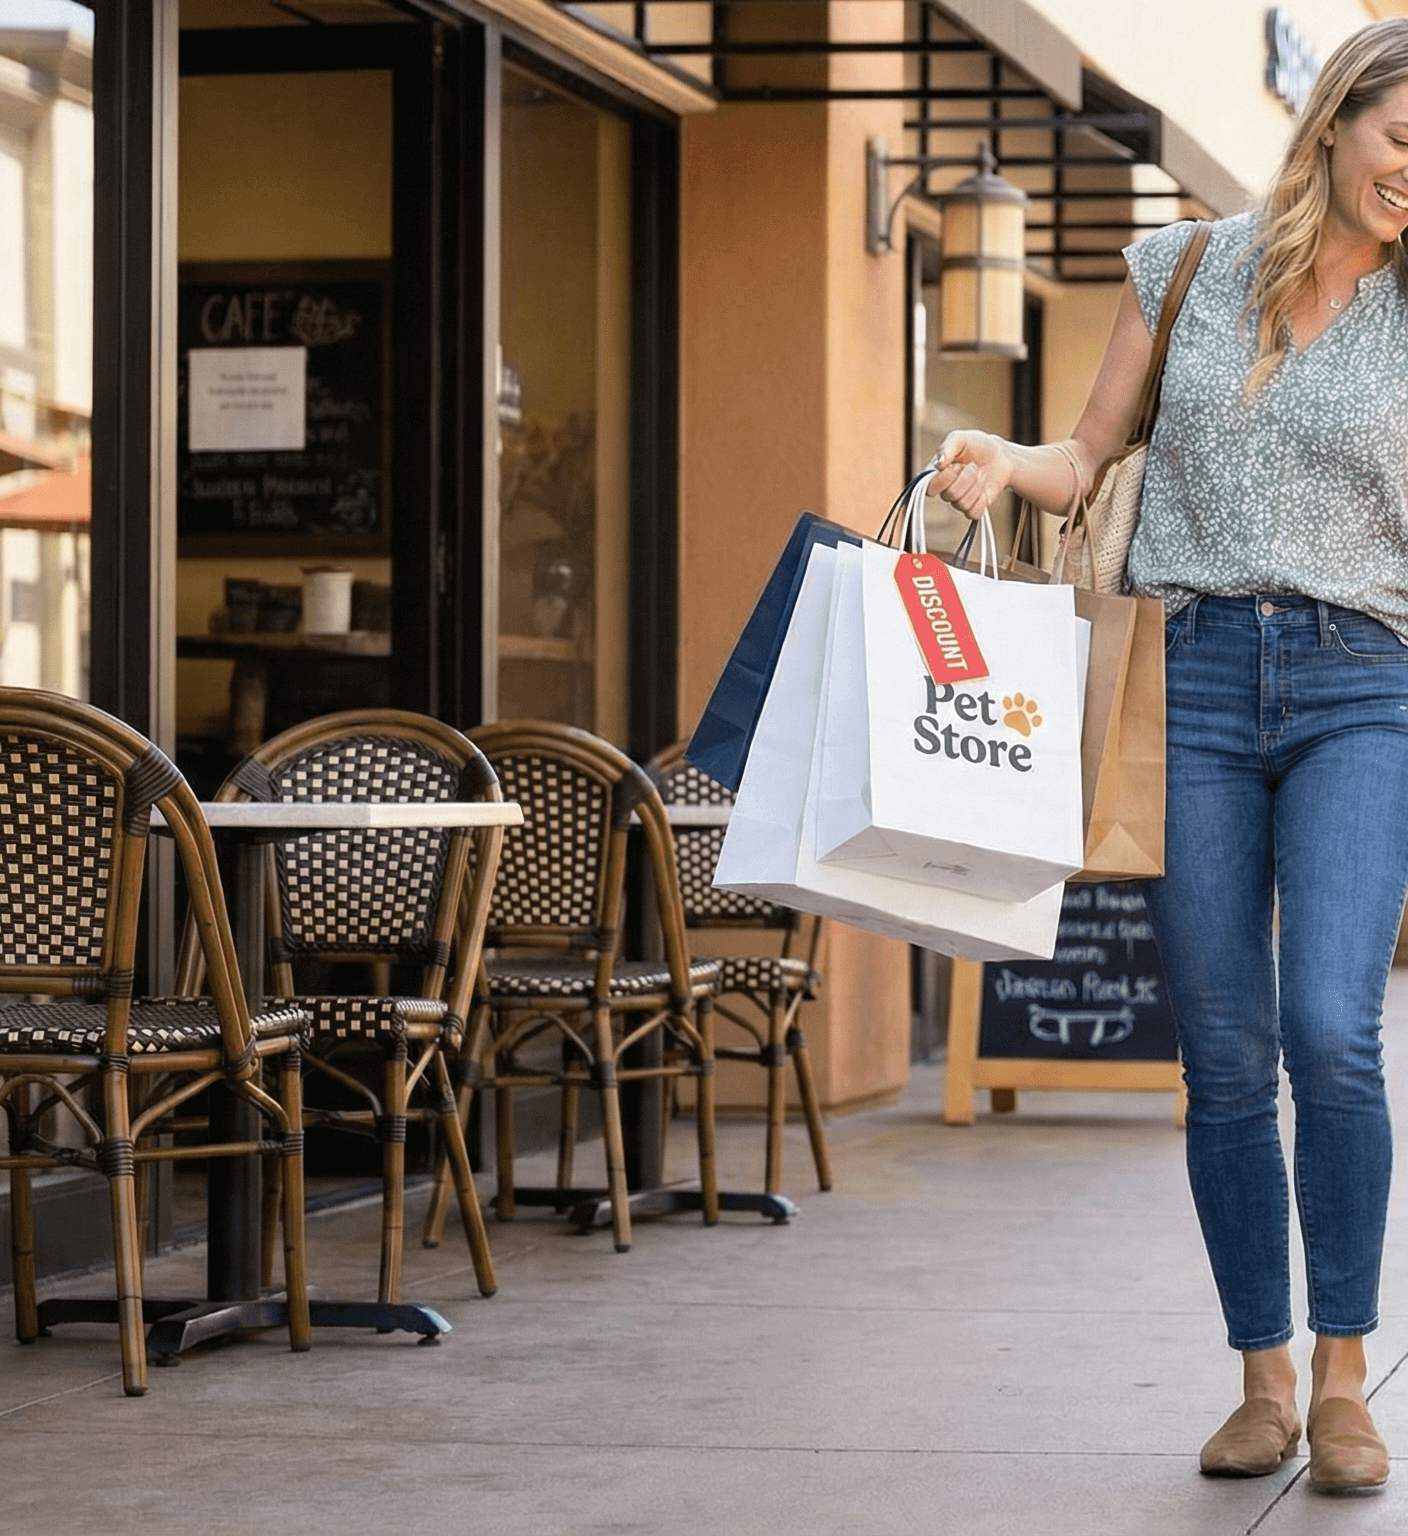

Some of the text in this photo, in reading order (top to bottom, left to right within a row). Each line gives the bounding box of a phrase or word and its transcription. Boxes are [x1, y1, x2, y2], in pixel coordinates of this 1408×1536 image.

[911, 575, 969, 671] DISCOUNT
[923, 675, 998, 726] Pet
[913, 715, 1033, 773] Store
